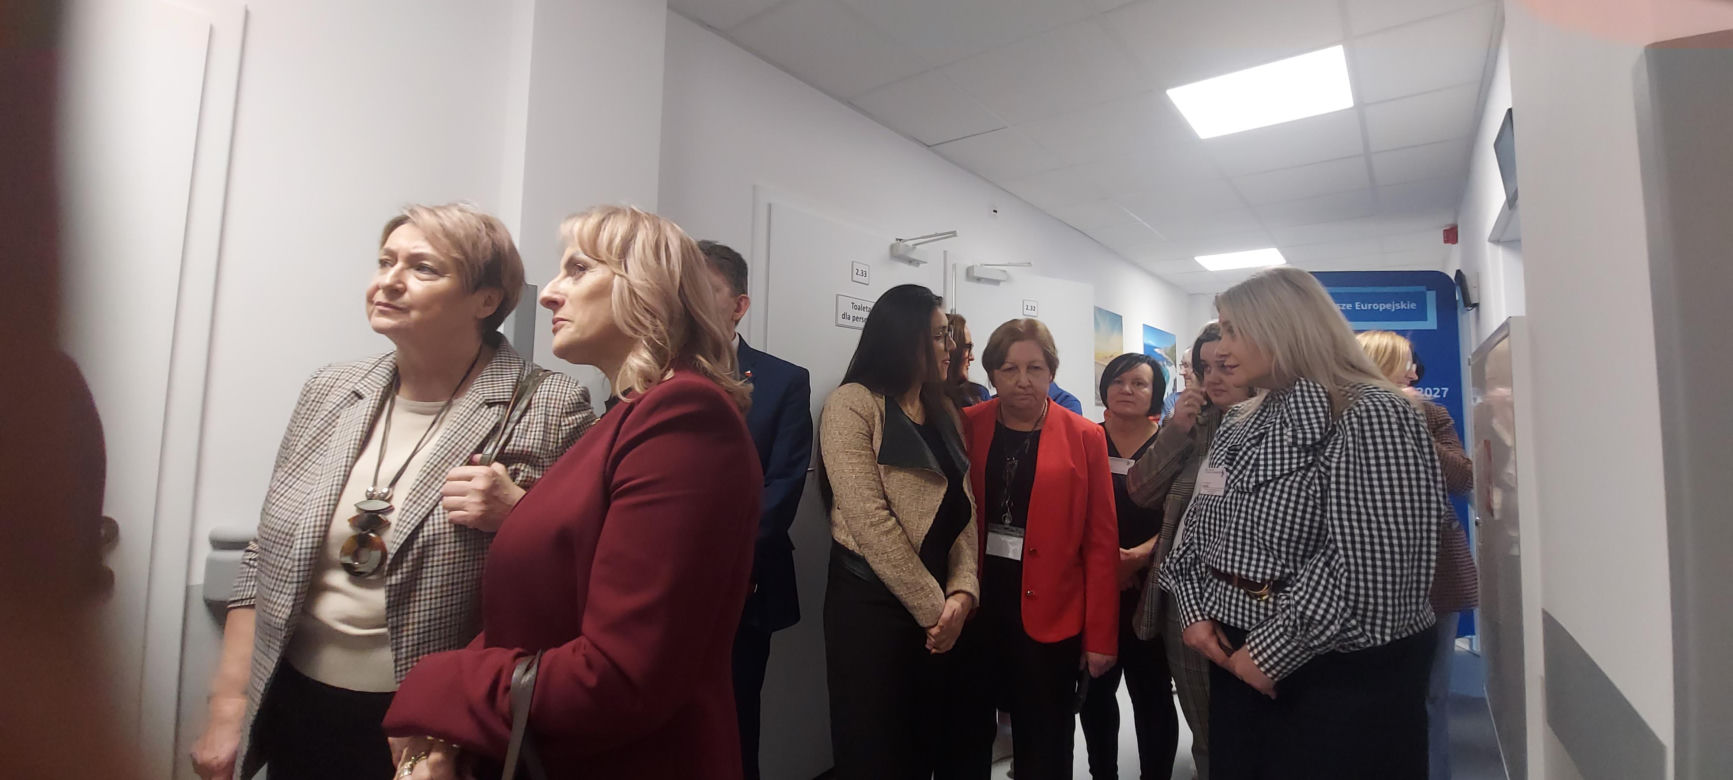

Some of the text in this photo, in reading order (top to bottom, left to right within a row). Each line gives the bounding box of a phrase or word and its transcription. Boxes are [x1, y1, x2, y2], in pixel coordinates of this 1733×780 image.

[855, 268, 868, 278] 2.33
[851, 302, 872, 313] Toaleta
[1355, 301, 1417, 312] Europejskie
[841, 311, 851, 321] dla
